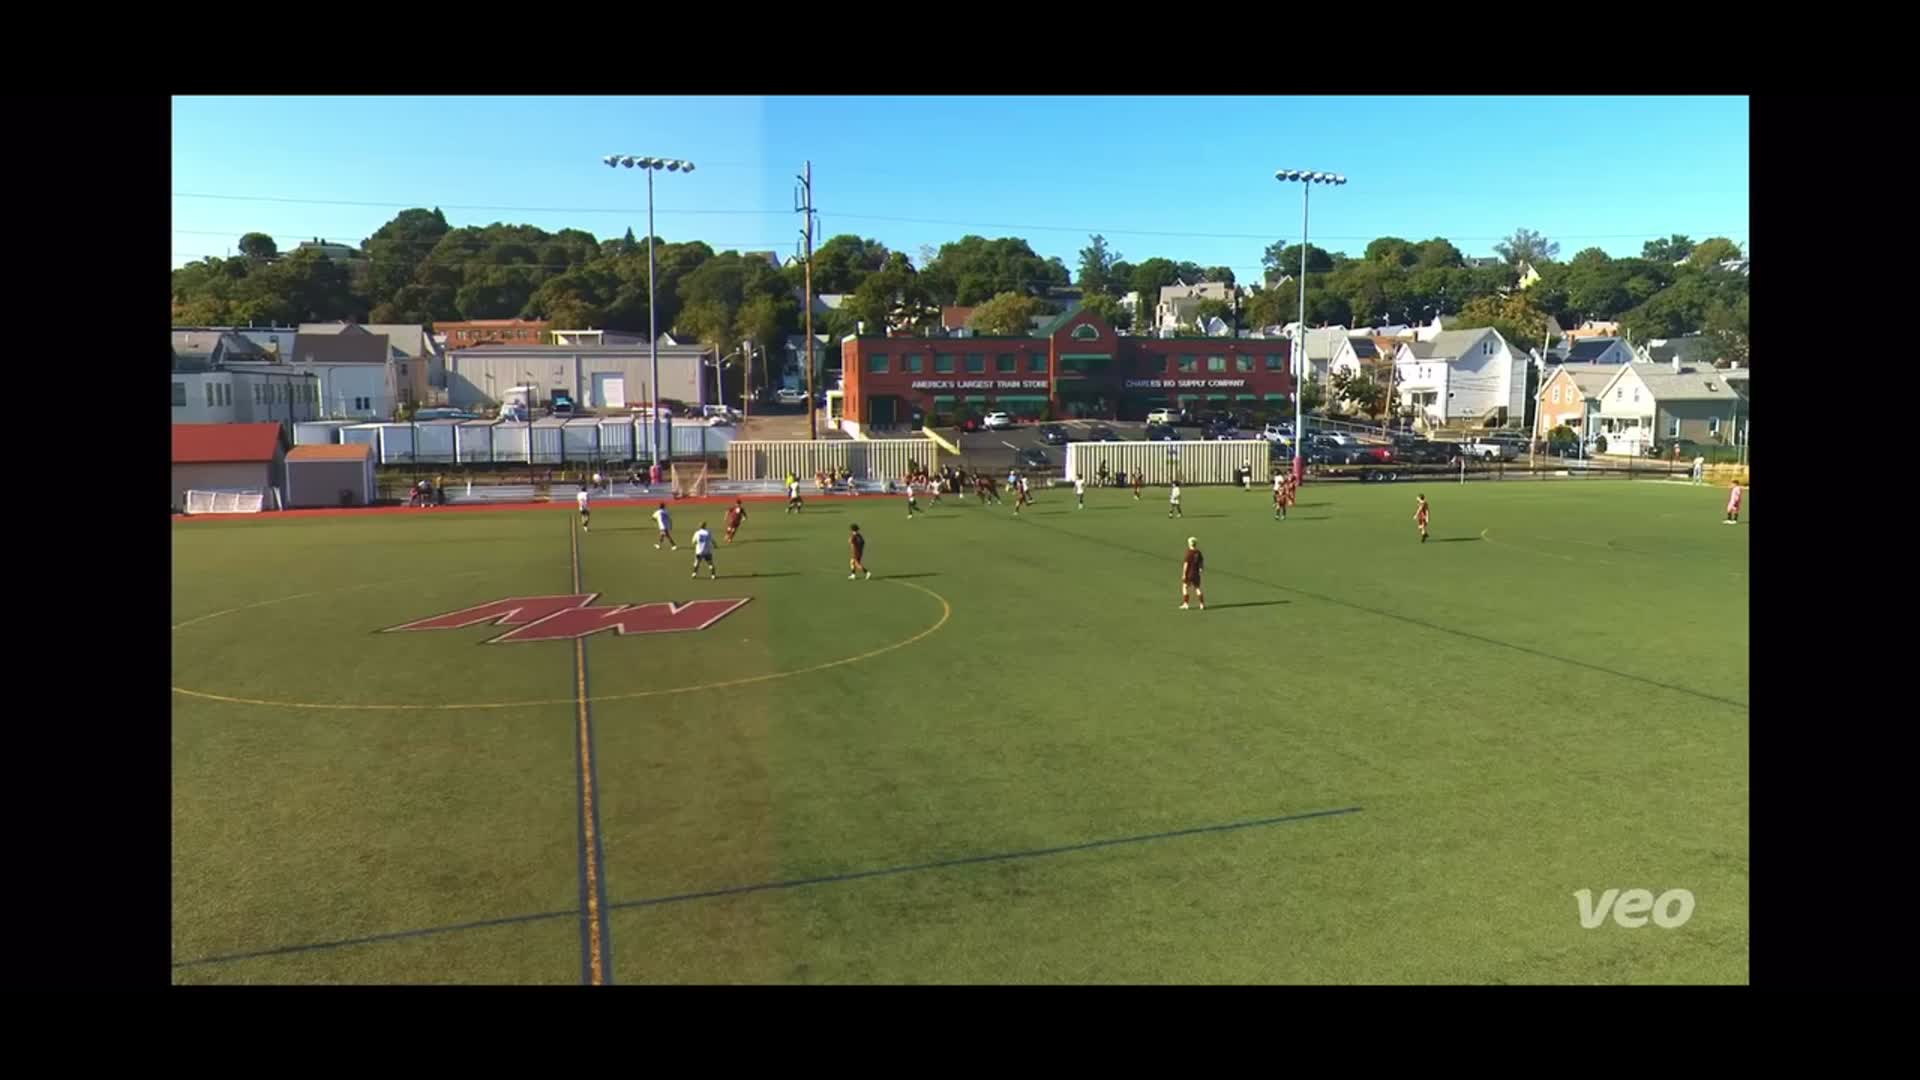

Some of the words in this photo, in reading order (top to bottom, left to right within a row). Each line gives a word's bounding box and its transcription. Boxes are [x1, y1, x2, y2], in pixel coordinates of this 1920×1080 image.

[911, 380, 955, 389] AMERICA'S
[957, 380, 994, 389] LARGEST
[996, 380, 1020, 389] TRAIN
[1023, 380, 1048, 388] STORE
[1126, 380, 1161, 388] CHARLES
[1178, 380, 1206, 388] SUPPLY
[1208, 380, 1245, 388] COMPANY
